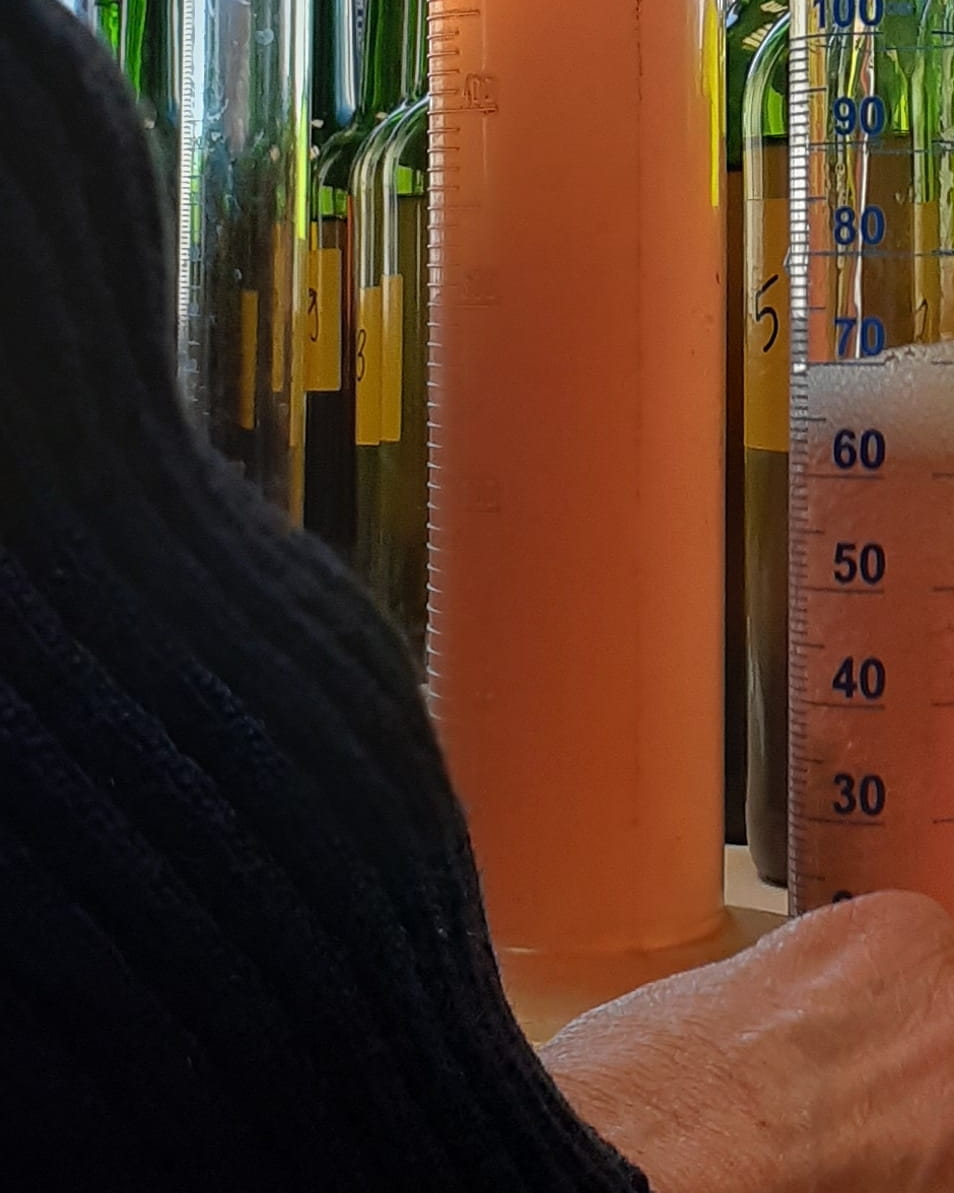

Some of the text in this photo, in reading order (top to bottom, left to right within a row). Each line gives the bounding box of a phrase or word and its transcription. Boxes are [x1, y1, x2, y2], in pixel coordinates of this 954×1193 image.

[833, 96, 885, 136] 90
[833, 205, 885, 245] 80
[834, 316, 885, 357] 70
[833, 428, 886, 469] 60
[833, 542, 886, 585] 50
[832, 657, 886, 699] 40
[832, 773, 886, 815] 30
